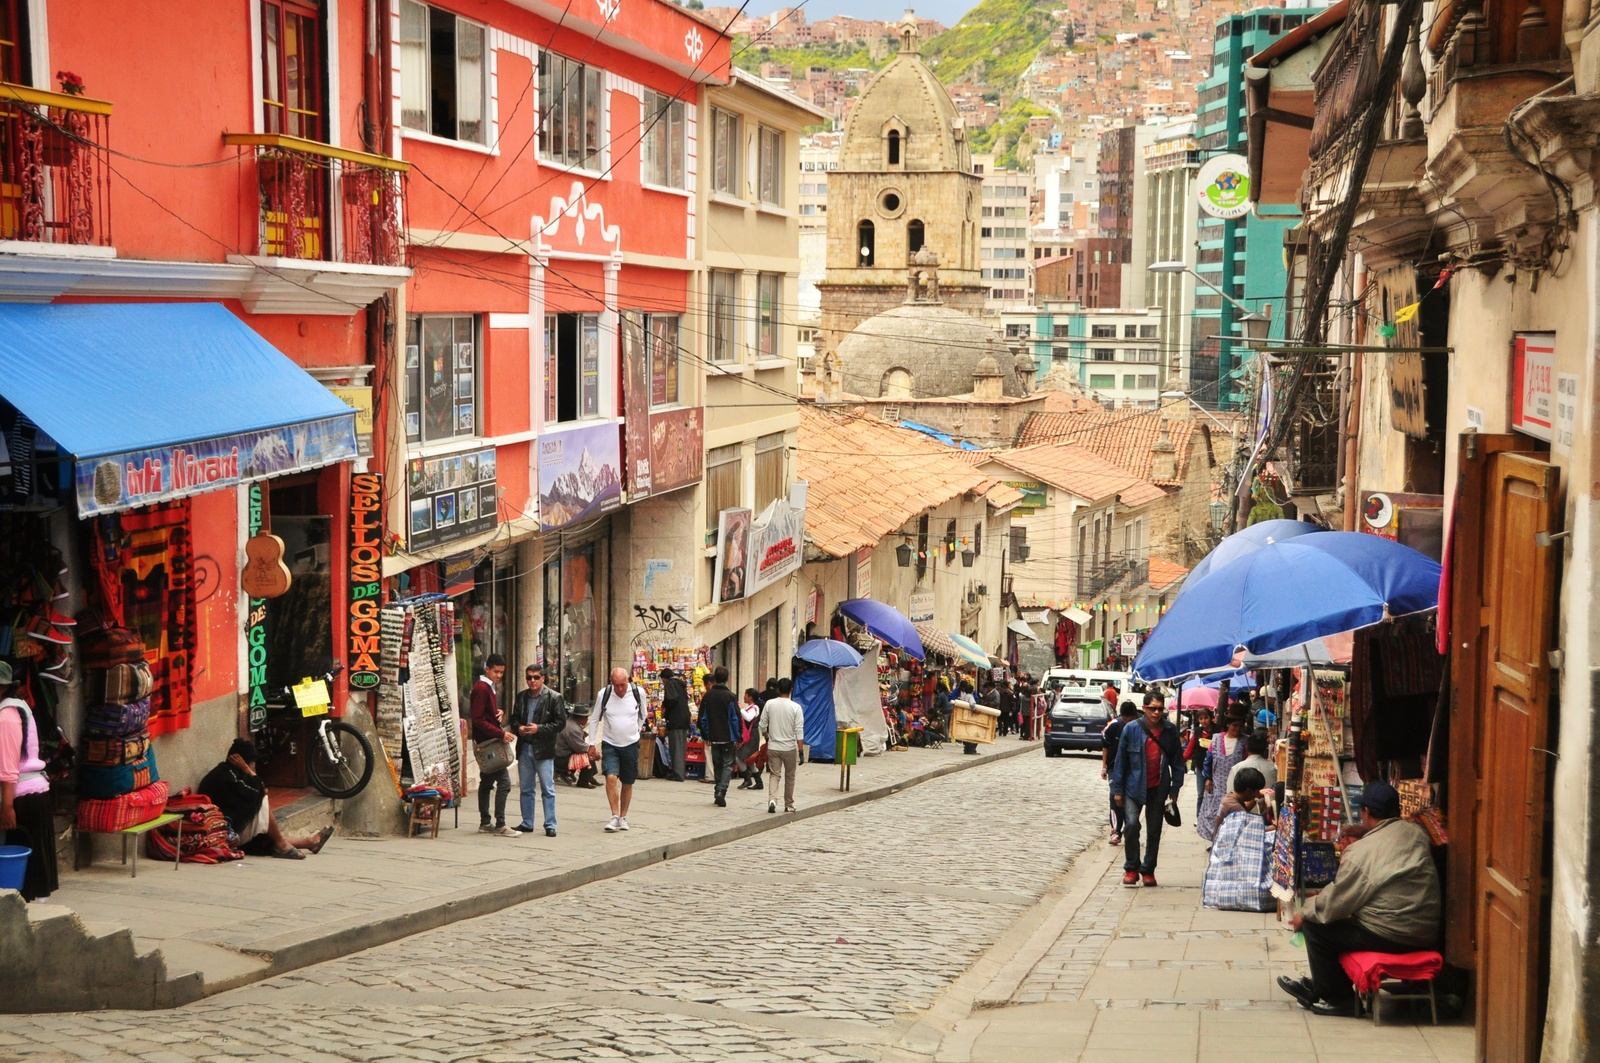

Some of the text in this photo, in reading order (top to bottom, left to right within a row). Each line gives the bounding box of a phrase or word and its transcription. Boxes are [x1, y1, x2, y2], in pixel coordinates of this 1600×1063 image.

[351, 474, 381, 582] SELLOS
[250, 605, 267, 627] DE
[352, 582, 380, 600] DE
[249, 626, 267, 707] GOMA
[350, 600, 381, 672] GOMA
